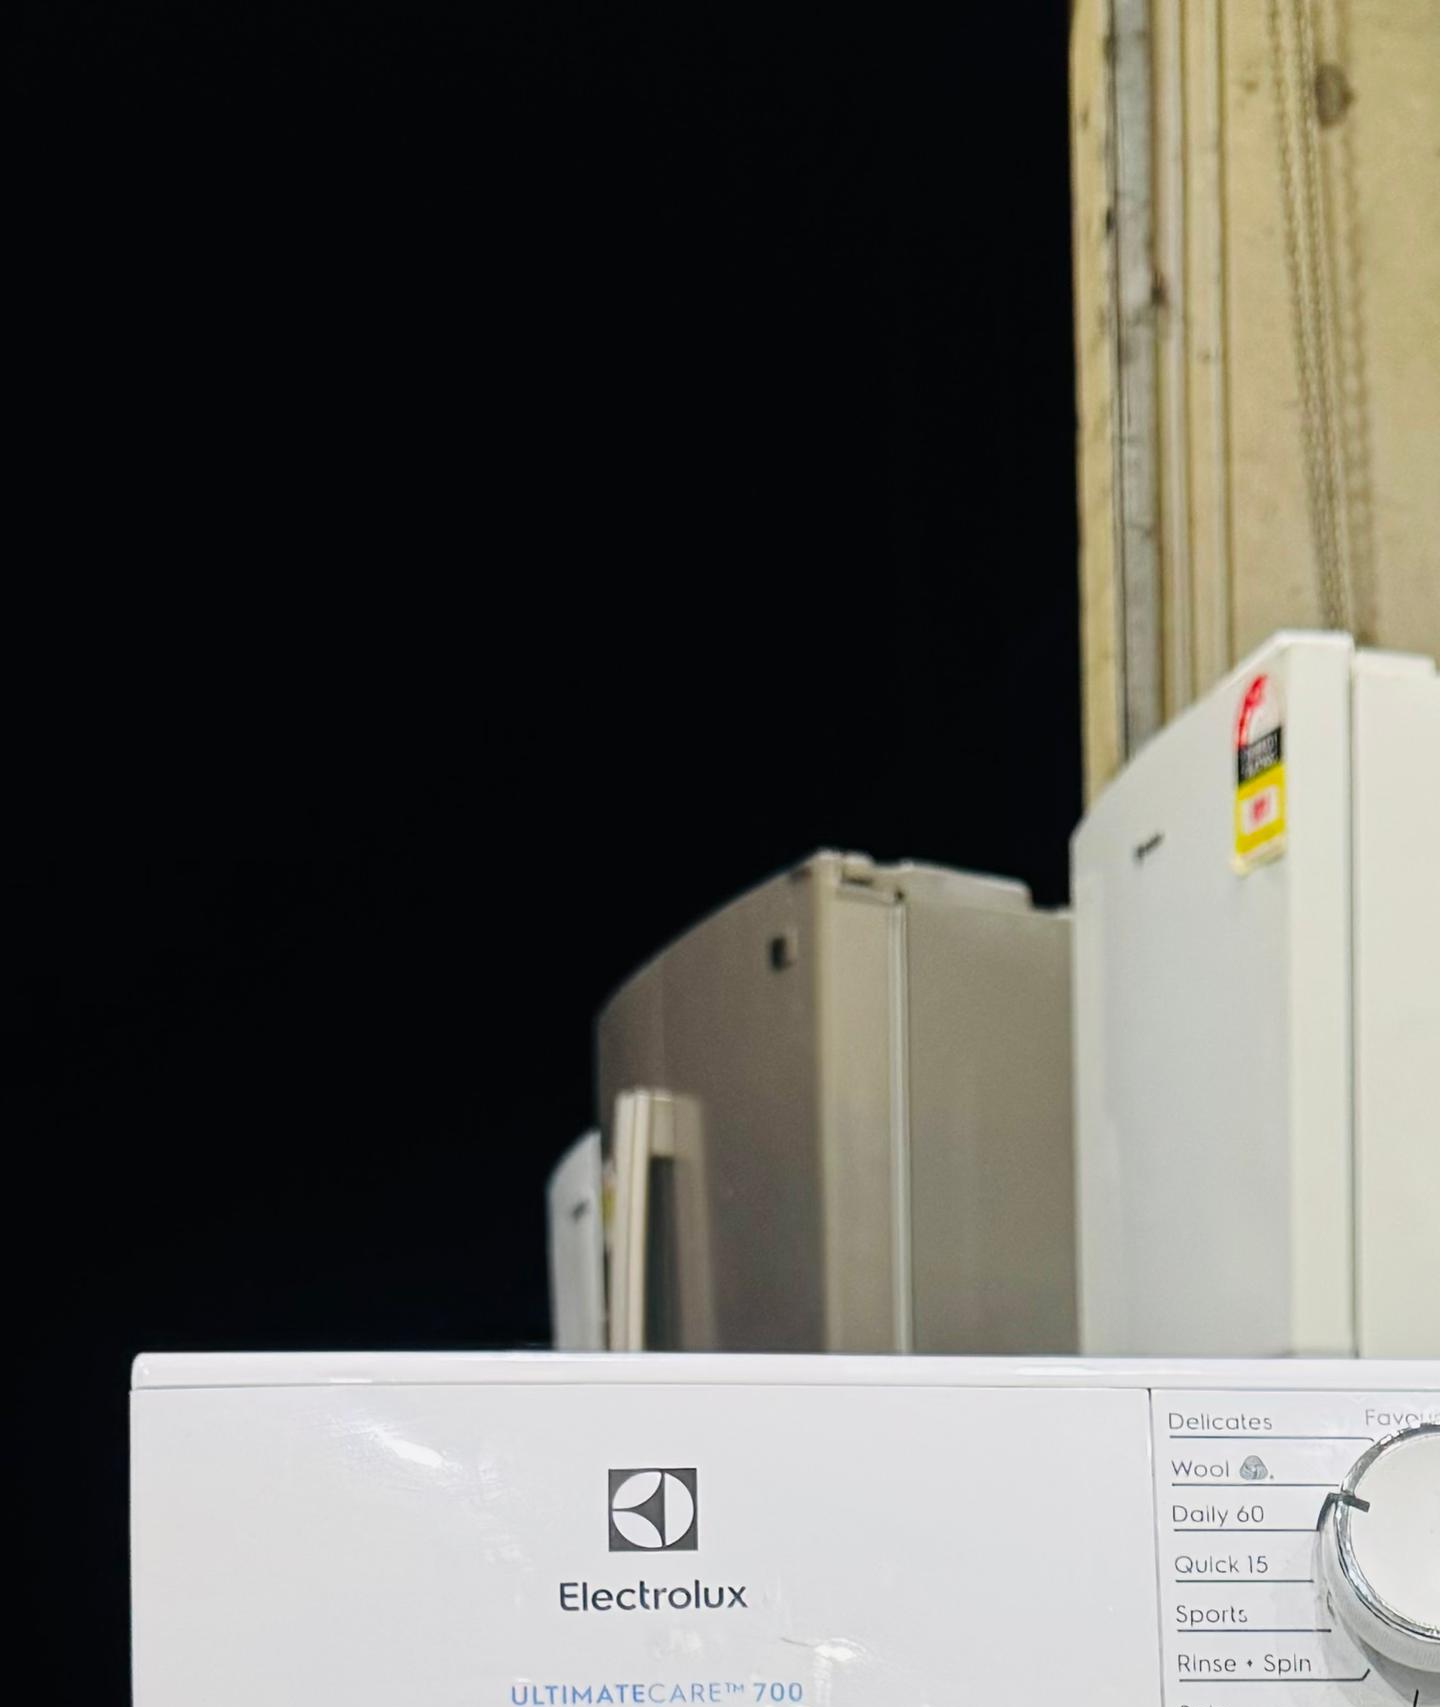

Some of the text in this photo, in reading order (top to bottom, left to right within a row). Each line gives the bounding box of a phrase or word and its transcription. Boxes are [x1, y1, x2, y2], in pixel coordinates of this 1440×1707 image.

[1169, 1413, 1273, 1430] Delicates
[1172, 1460, 1229, 1478] Wool
[1172, 1505, 1264, 1527] Daily 60
[1175, 1555, 1269, 1573] Quick 15
[559, 1580, 749, 1612] Electrolux
[1176, 1605, 1248, 1627] Sports
[1178, 1654, 1237, 1673] Rinse
[1264, 1653, 1311, 1676] Spin
[753, 1682, 803, 1703] 700
